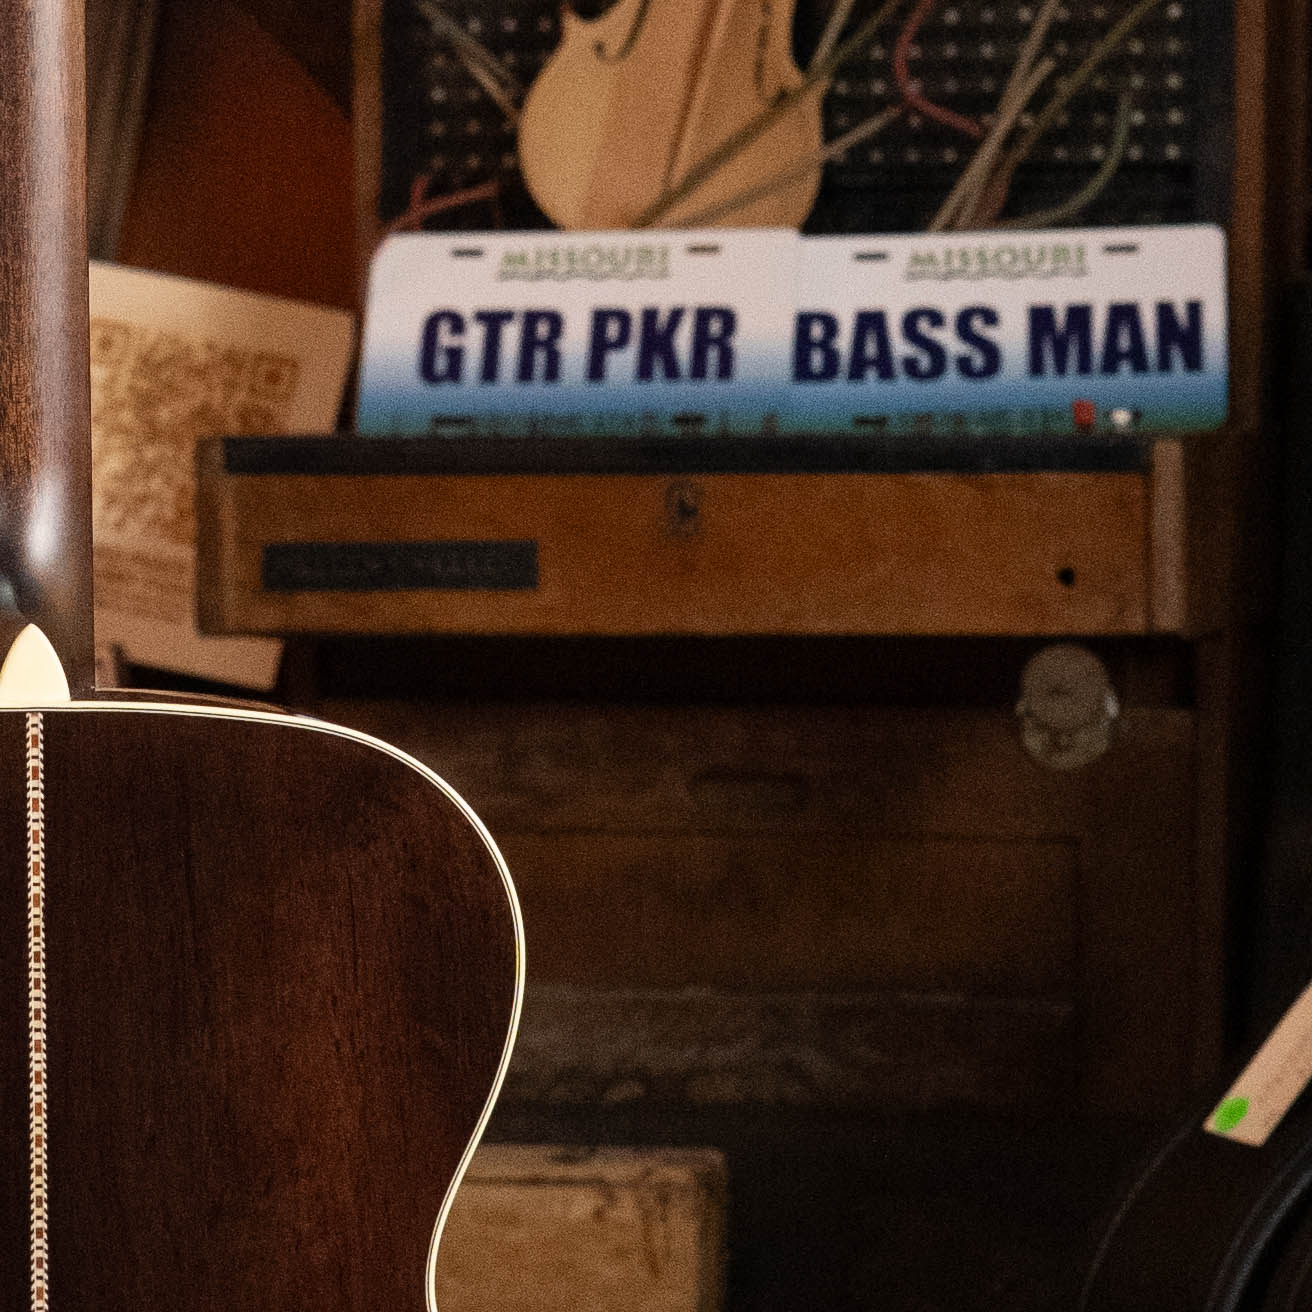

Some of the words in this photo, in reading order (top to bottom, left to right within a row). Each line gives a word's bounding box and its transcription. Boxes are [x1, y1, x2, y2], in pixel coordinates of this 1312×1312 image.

[499, 245, 673, 277] MISSOURI
[906, 241, 1089, 276] MISSOURI
[418, 307, 565, 387] GTR
[585, 304, 740, 385] PKR
[790, 305, 1004, 385] BASS
[1027, 298, 1206, 379] MAN
